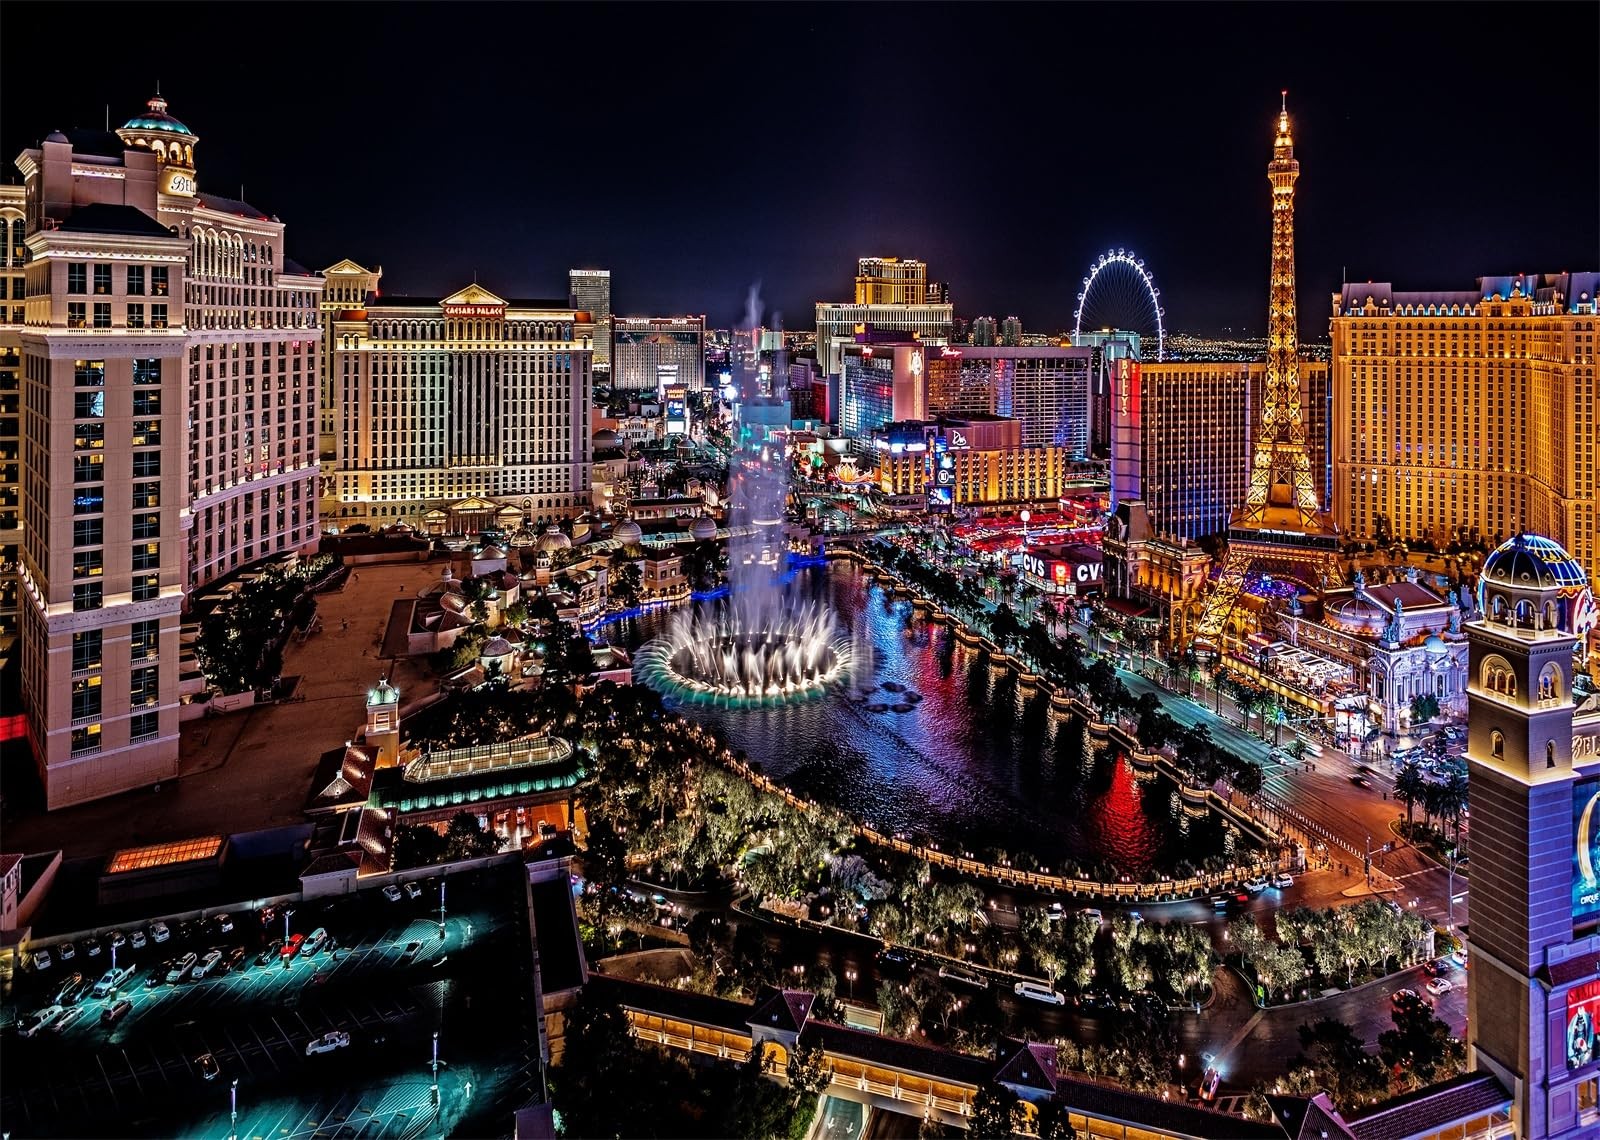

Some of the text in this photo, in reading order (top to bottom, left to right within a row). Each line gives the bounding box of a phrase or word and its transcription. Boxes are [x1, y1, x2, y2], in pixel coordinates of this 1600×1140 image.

[445, 307, 503, 315] CAESARS PALACE
[1023, 553, 1045, 577] CVS
